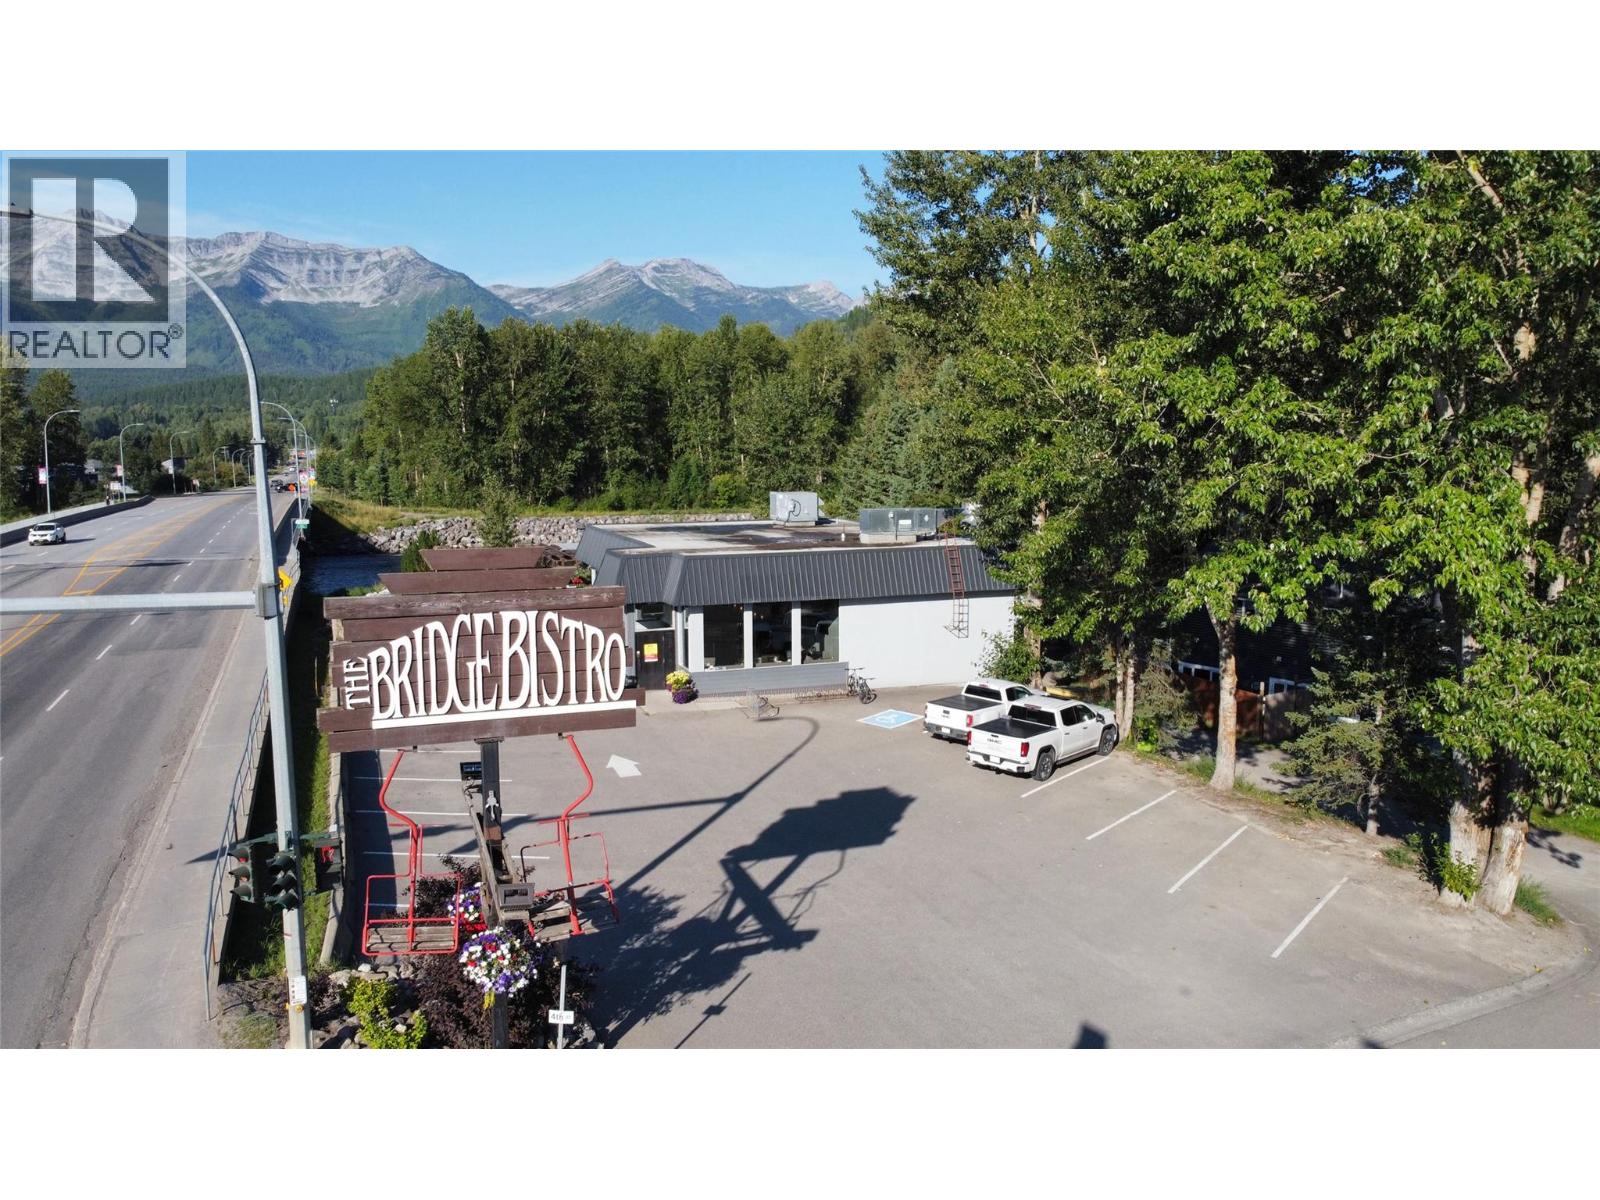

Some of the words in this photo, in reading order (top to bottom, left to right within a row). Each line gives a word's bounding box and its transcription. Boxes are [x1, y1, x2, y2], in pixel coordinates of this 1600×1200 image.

[342, 656, 370, 710] THE
[367, 612, 498, 720] BRIDGE
[498, 610, 627, 711] BISTRO
